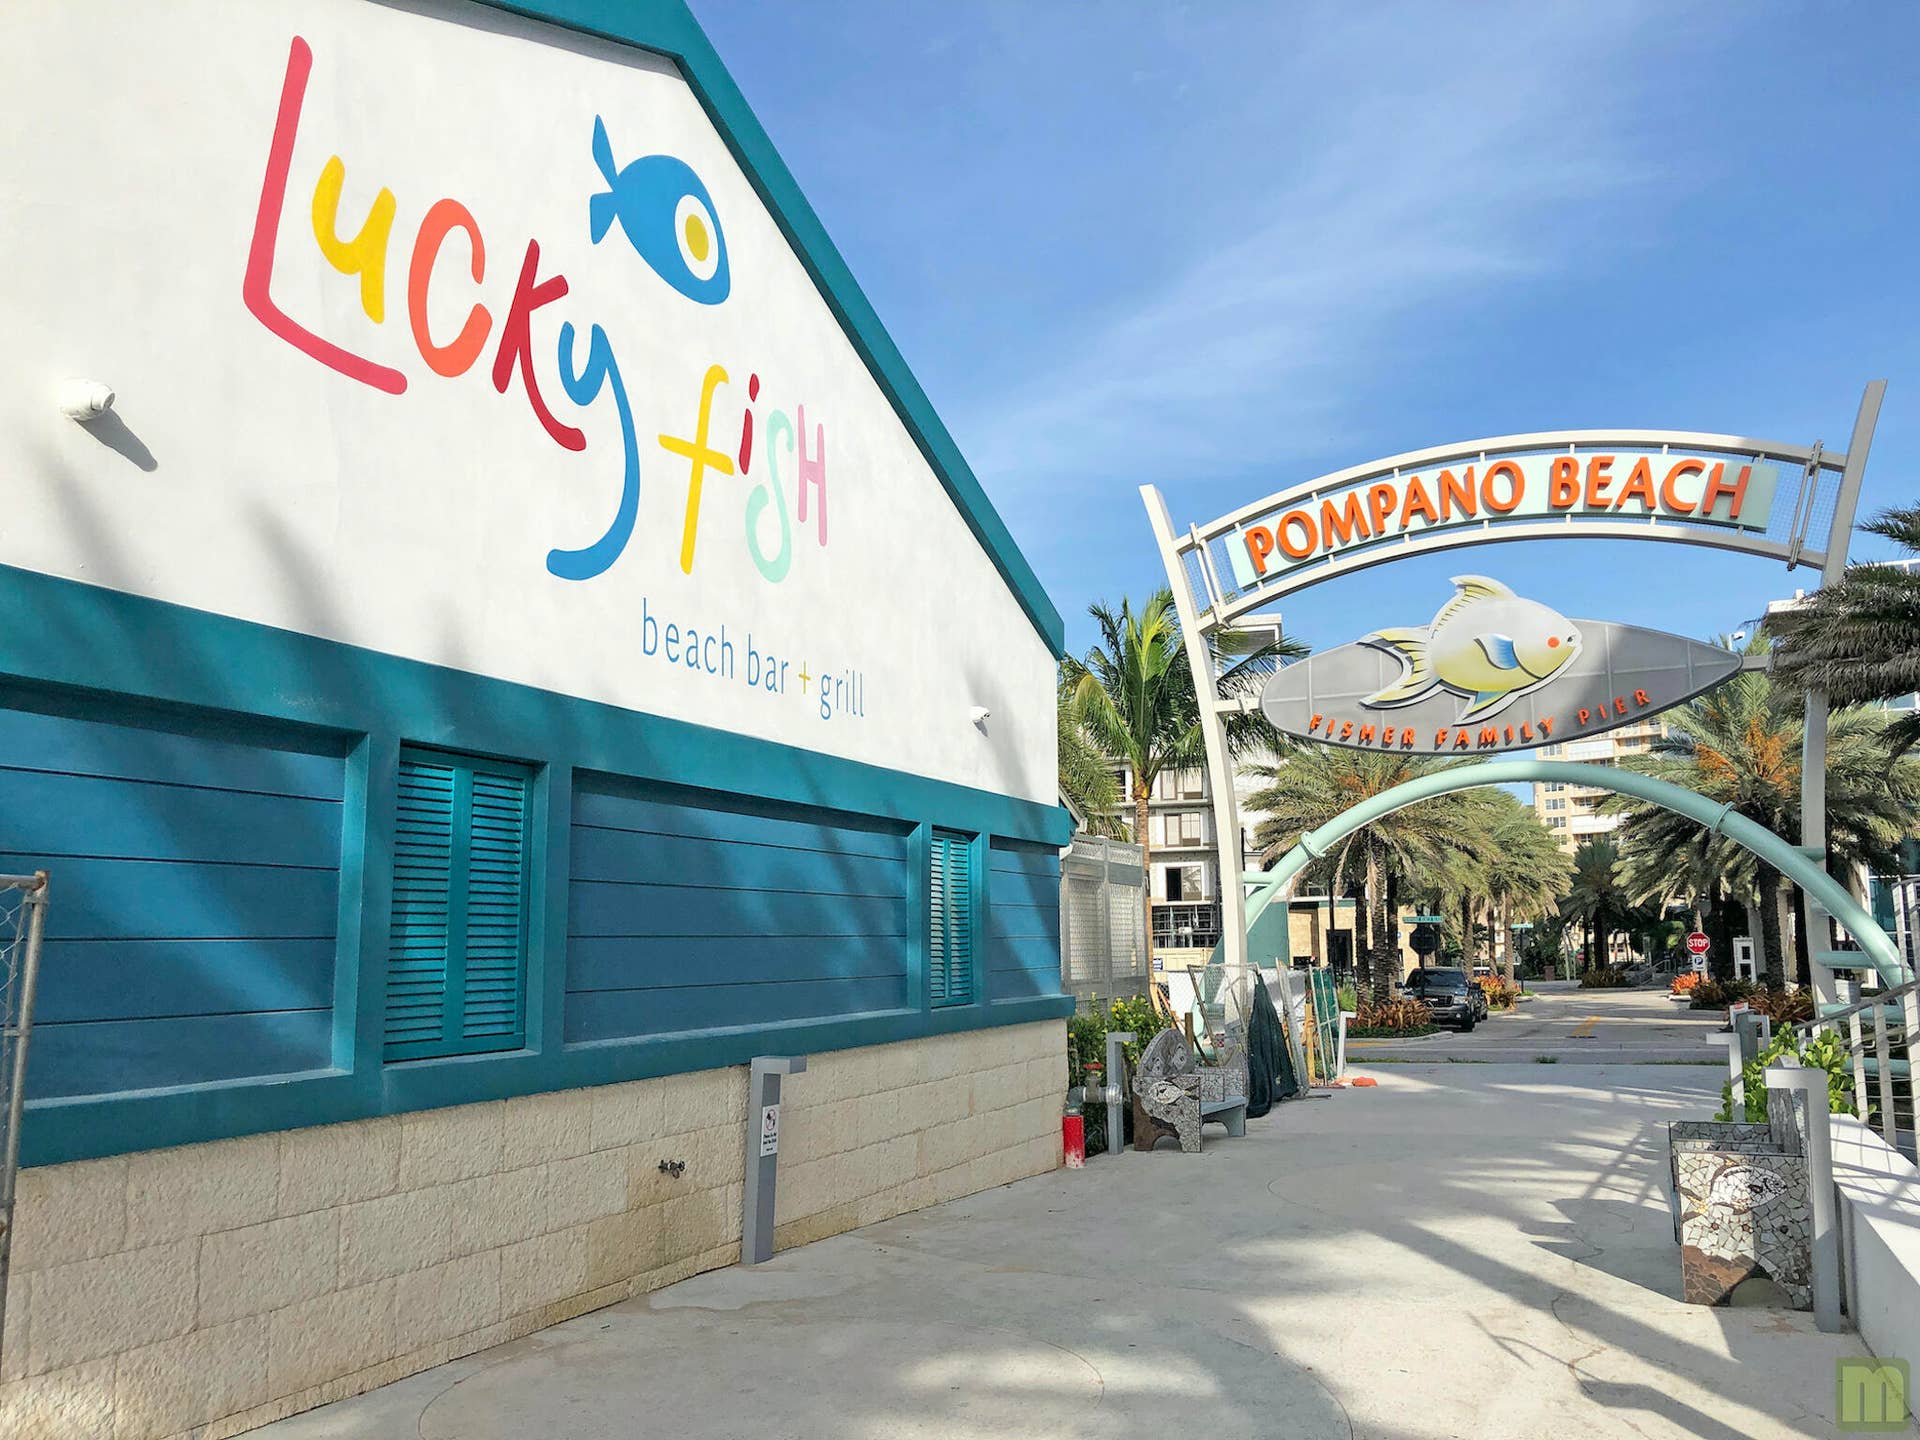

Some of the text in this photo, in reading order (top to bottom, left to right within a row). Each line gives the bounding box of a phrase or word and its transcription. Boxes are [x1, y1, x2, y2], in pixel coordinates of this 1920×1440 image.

[1245, 455, 1753, 574] POMPANO BEACH
[643, 597, 865, 720] beach bar + grill
[1309, 688, 1652, 746] FISHER FAMILY PIER
[1688, 938, 1708, 948] STOP
